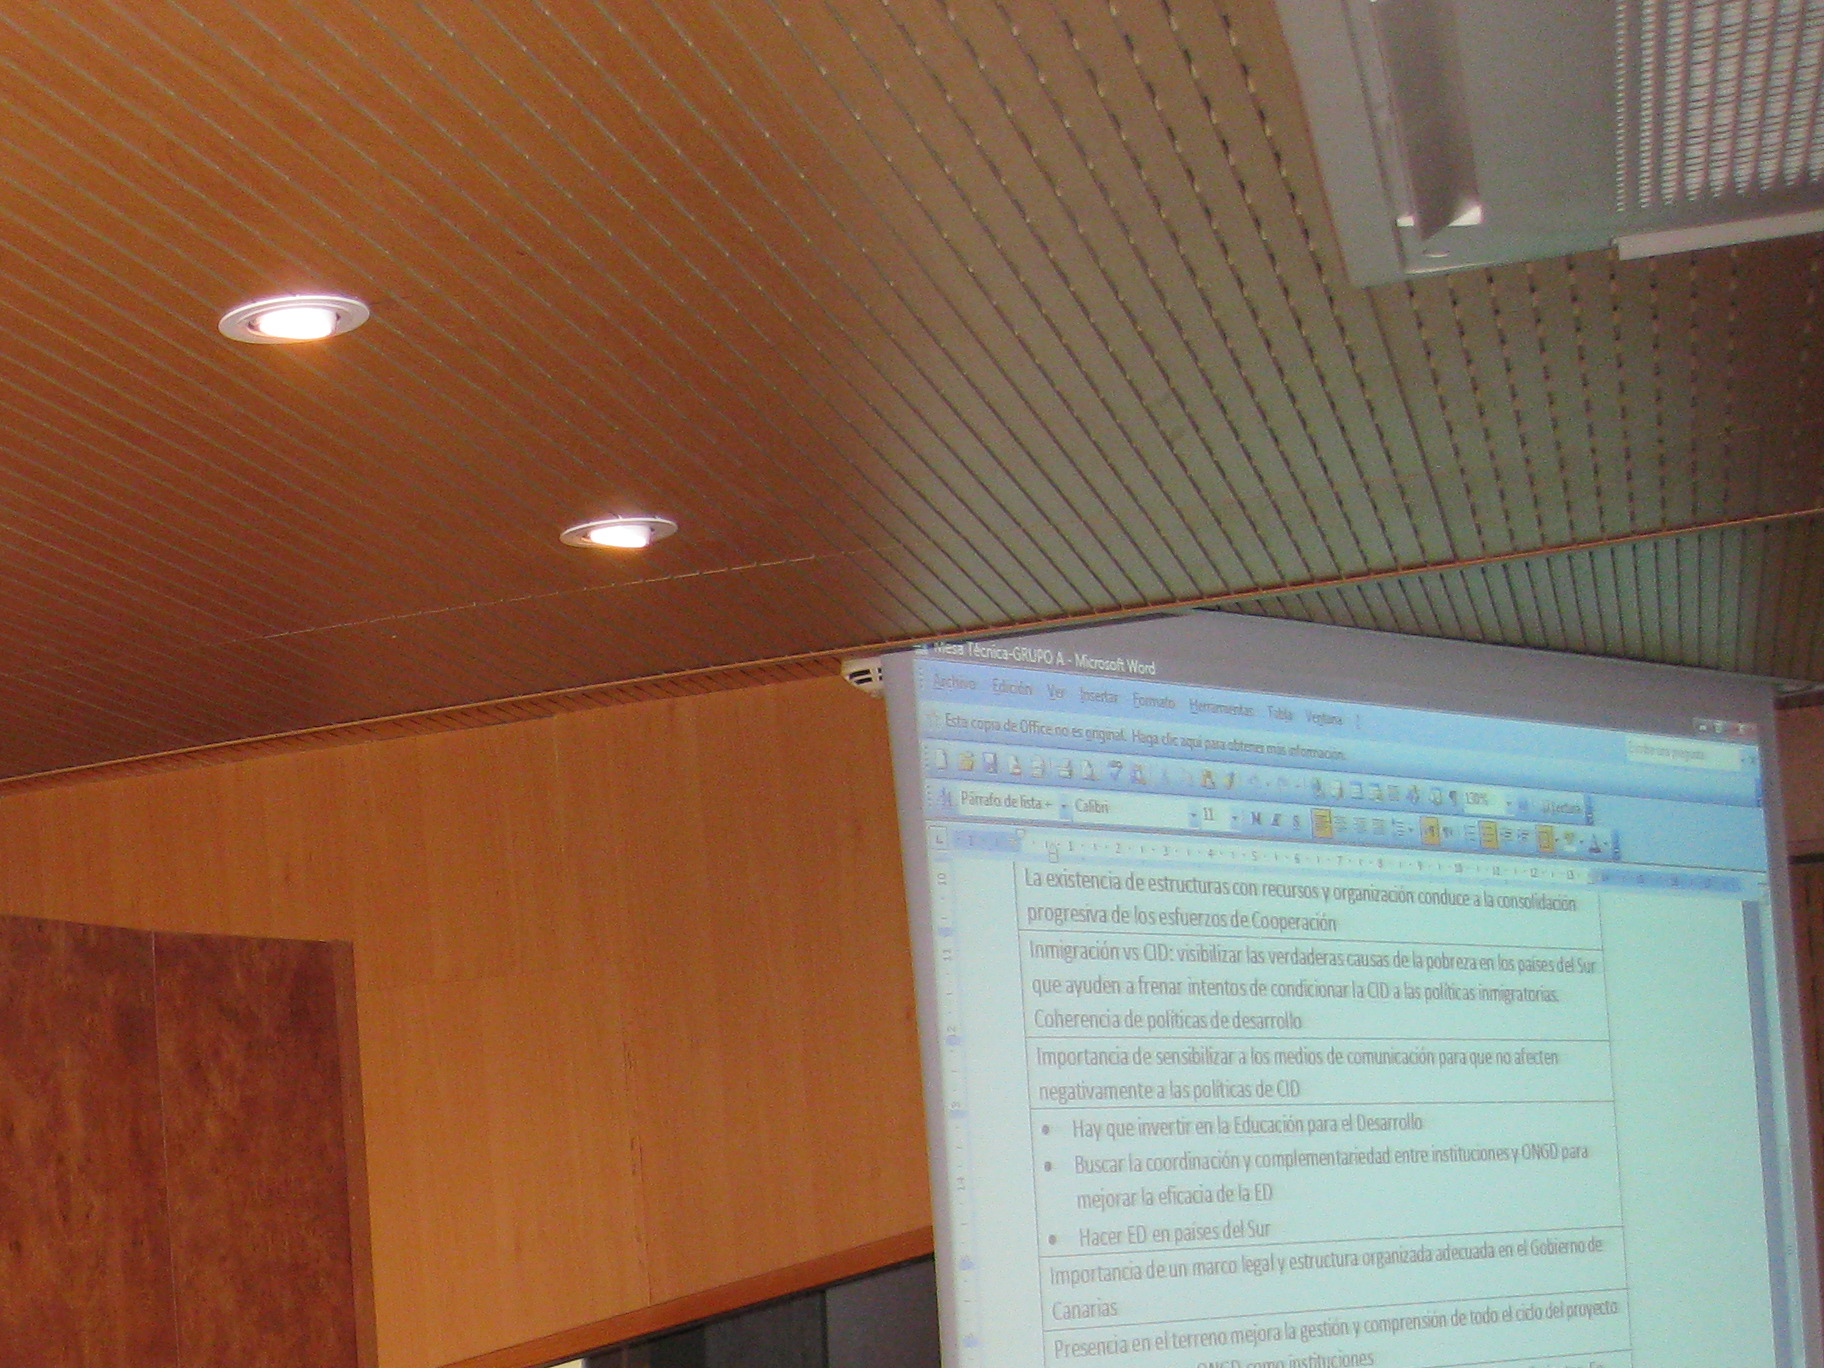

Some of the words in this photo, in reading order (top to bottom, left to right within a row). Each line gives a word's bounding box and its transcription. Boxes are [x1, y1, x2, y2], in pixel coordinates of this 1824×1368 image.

[1055, 655, 1065, 667] A
[1075, 654, 1126, 673] Microsoft
[1127, 658, 1156, 676] Word
[945, 713, 970, 730] Esta
[971, 717, 1001, 736] copia
[1004, 717, 1018, 734] de
[1019, 719, 1053, 736] Office
[1055, 725, 1069, 738] no
[1072, 727, 1084, 739] es
[1132, 730, 1159, 747] Haga
[1204, 737, 1226, 753] para
[961, 790, 1001, 809] Párrafo
[1003, 793, 1018, 808] de
[1020, 794, 1043, 810] lista
[1075, 798, 1110, 815] Calibri
[1024, 866, 1042, 885] La
[1045, 868, 1122, 889] existencia
[1124, 872, 1145, 890] de
[1147, 873, 1230, 894] estructuras
[1231, 882, 1258, 895] con
[1261, 884, 1319, 898] recursos
[1321, 887, 1331, 903] y
[1332, 883, 1415, 907] organización
[1416, 888, 1470, 906] conduce
[1472, 895, 1481, 906] a
[1482, 891, 1495, 907] la
[1495, 892, 1578, 911] consolidación
[1026, 902, 1108, 927] progresiva
[1110, 906, 1130, 923] de
[1133, 907, 1156, 924] los
[1158, 908, 1227, 927] esfuerzos
[1229, 911, 1249, 928] de
[1250, 912, 1338, 936] Cooperación
[1029, 939, 1120, 963] Inmigración
[1122, 947, 1139, 959] vs
[1176, 944, 1242, 962] visibilizar
[1245, 946, 1265, 963] las
[1267, 947, 1344, 965] verdaderas
[1345, 954, 1390, 967] causas
[1392, 951, 1409, 967] de
[1411, 952, 1423, 968] la
[1425, 952, 1477, 974] pobreza
[1478, 958, 1495, 970] en
[1497, 955, 1515, 970] los
[1555, 957, 1575, 972] del
[1576, 957, 1597, 973] Sur
[1031, 978, 1062, 996] que
[1065, 974, 1121, 998] ayuden
[1125, 981, 1135, 993] a
[1137, 976, 1182, 994] frenar
[1187, 977, 1247, 995] intentos
[1248, 979, 1267, 996] de
[1269, 979, 1349, 997] condicionar
[1351, 981, 1365, 998] la
[1366, 982, 1390, 998] CID
[1392, 987, 1401, 998] a
[1403, 983, 1421, 999] las
[1423, 983, 1476, 1004] políticas
[1033, 1009, 1121, 1027] Coherencia
[1123, 1010, 1143, 1028] de
[1146, 1011, 1208, 1033] políticas
[1209, 1012, 1229, 1028] de
[1231, 1012, 1304, 1029] desarrollo
[1036, 1047, 1129, 1069] Importancia
[1131, 1047, 1152, 1064] de
[1155, 1047, 1234, 1064] sensibilizar
[1238, 1052, 1247, 1064] a
[1250, 1048, 1270, 1064] los
[1273, 1048, 1323, 1064] medios
[1325, 1048, 1344, 1064] de
[1345, 1048, 1436, 1064] comunicación
[1438, 1053, 1468, 1069] para
[1468, 1053, 1493, 1069] que
[1495, 1053, 1512, 1064] no
[1513, 1049, 1560, 1064] afecten
[1038, 1081, 1154, 1104] negativamente
[1156, 1086, 1166, 1098] a
[1169, 1081, 1190, 1098] las
[1192, 1080, 1252, 1102] políticas
[1254, 1080, 1273, 1097] de
[1275, 1080, 1301, 1097] CID
[1078, 1226, 1122, 1245] Hacer
[1126, 1224, 1147, 1242] ED
[1151, 1228, 1170, 1241] en
[1221, 1220, 1245, 1238] del
[1247, 1219, 1271, 1237] Sur
[1051, 1298, 1118, 1320] Canarias
